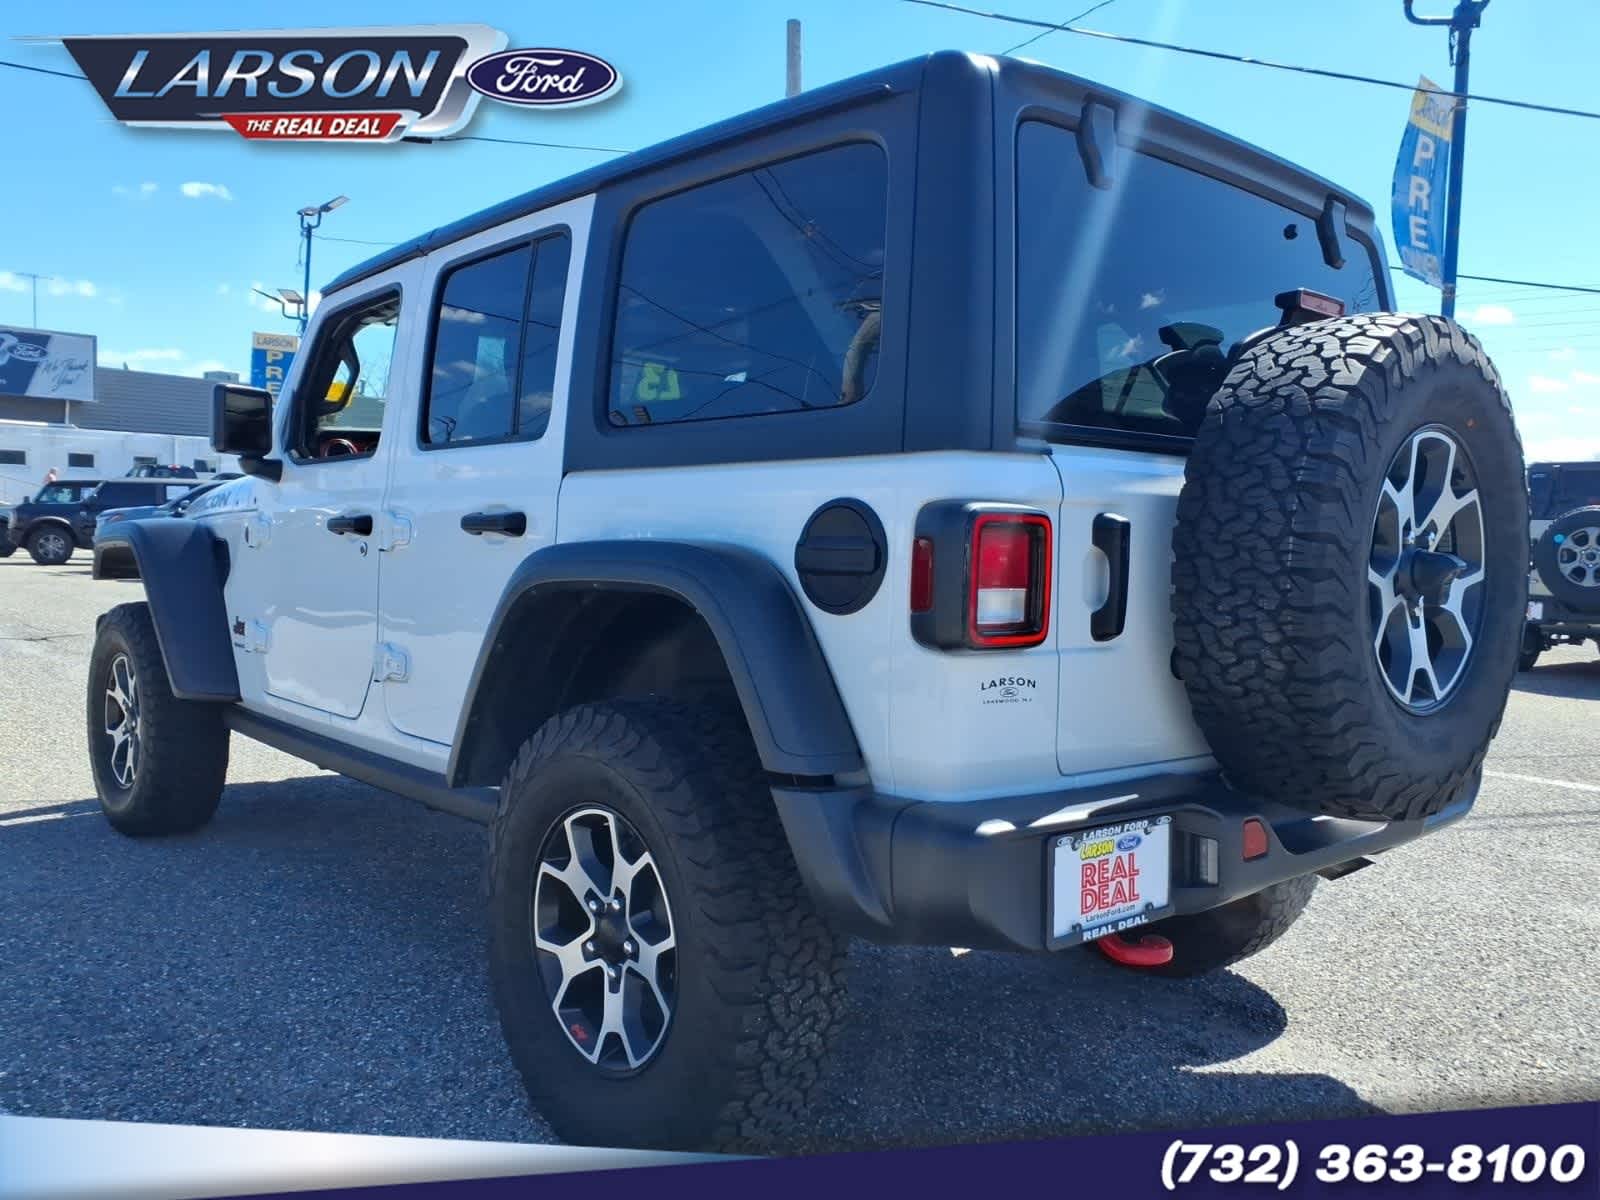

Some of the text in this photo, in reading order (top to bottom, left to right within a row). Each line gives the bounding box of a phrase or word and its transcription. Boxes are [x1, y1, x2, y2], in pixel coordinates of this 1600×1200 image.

[1408, 134, 1434, 250] PRE
[981, 677, 1036, 690] LARSON
[1083, 826, 1121, 842] LARSON
[1124, 820, 1149, 833] FORD
[1080, 839, 1115, 860] LARSON
[1081, 852, 1140, 888] REAL
[1080, 878, 1140, 915] DEAL
[1082, 914, 1149, 941] REAL DEAL
